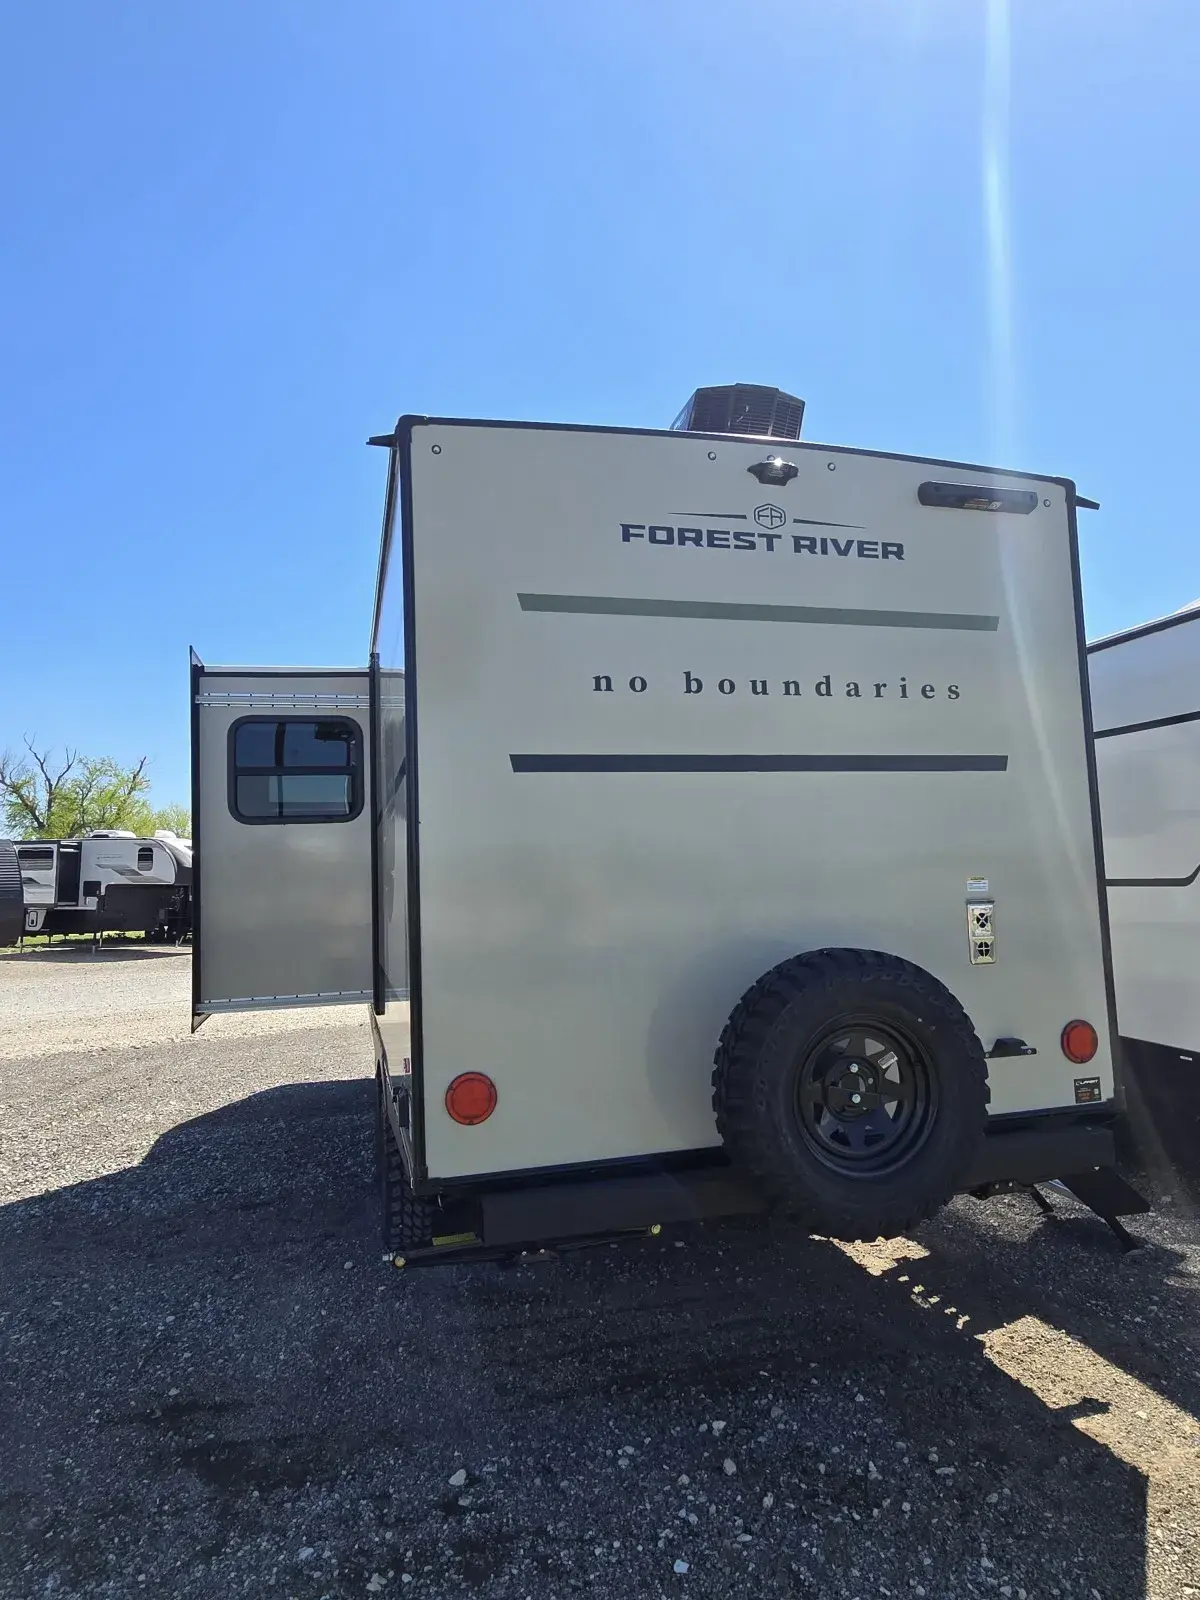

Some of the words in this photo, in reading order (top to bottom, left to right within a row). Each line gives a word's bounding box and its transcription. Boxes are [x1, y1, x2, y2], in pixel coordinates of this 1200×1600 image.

[620, 524, 781, 552] FOREST
[791, 535, 905, 560] RIVER
[592, 674, 648, 693] no
[683, 671, 960, 700] boundaries
